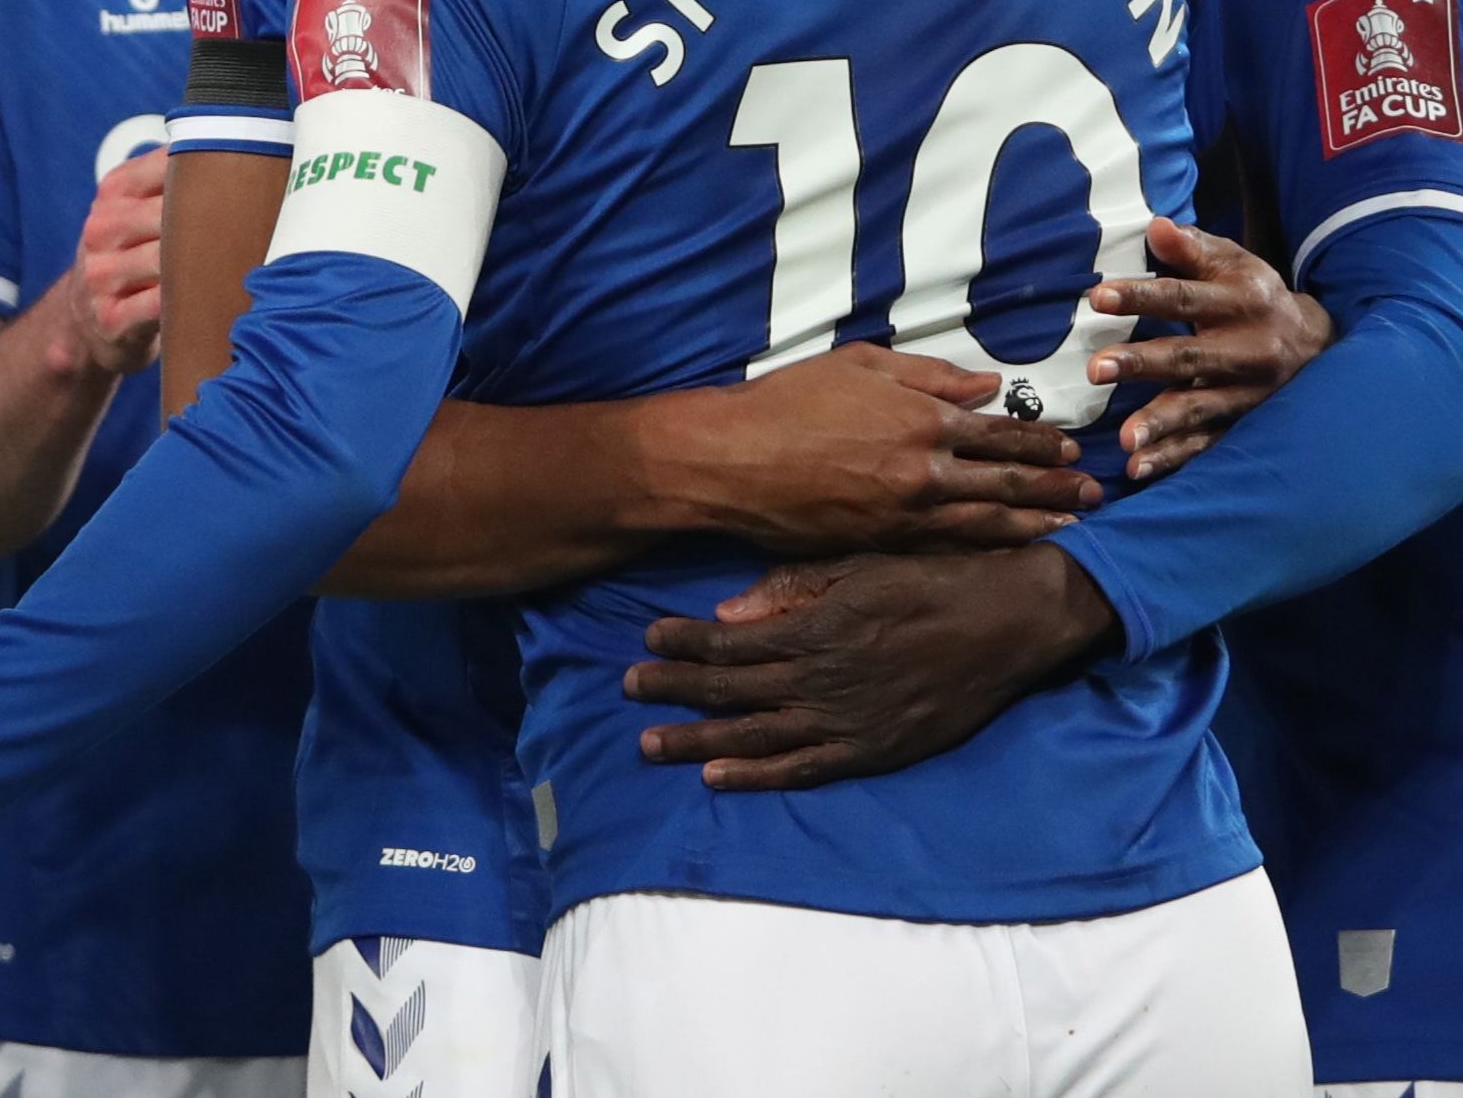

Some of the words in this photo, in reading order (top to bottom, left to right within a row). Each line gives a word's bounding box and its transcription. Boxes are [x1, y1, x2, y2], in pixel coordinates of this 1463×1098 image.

[200, 9, 228, 33] CUP
[1339, 75, 1444, 113] Emirates
[1342, 105, 1379, 135] FA
[1381, 94, 1447, 121] CUP
[288, 150, 437, 196] ESPECT
[727, 41, 1154, 430] 10
